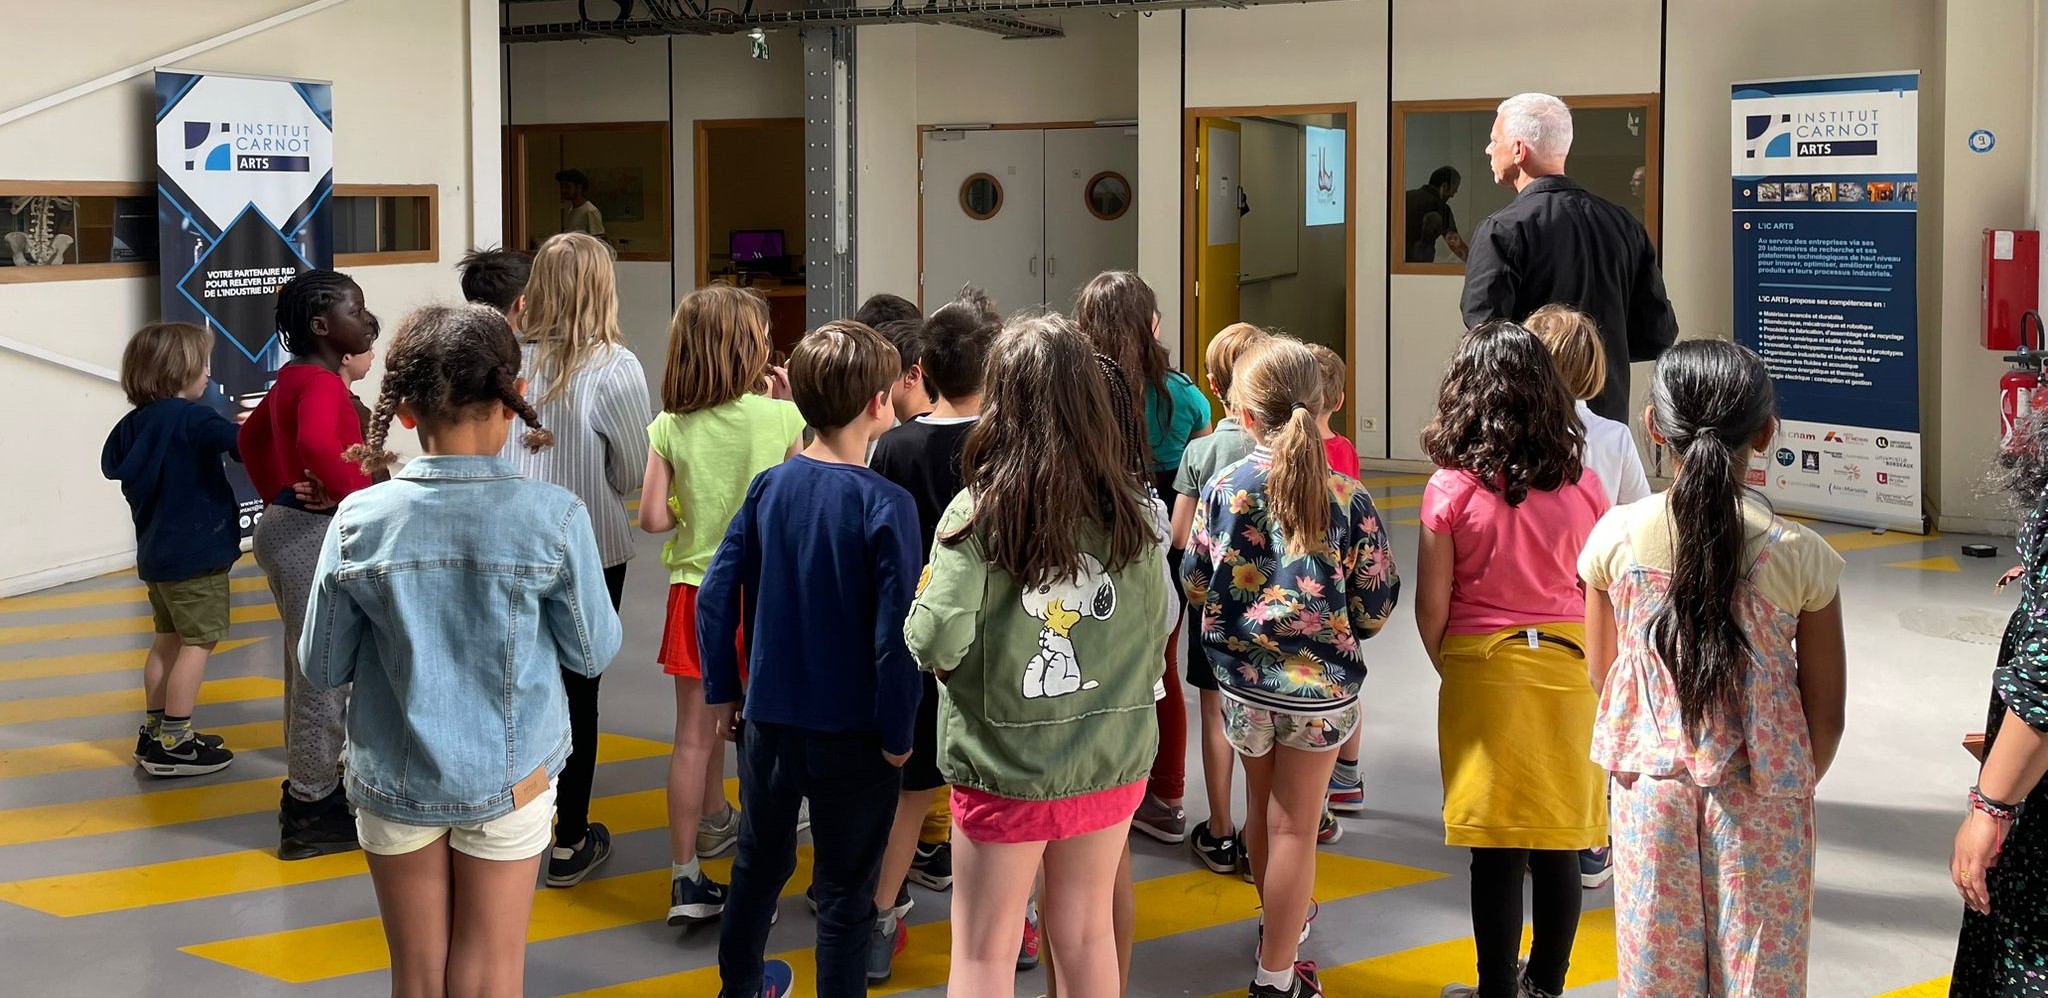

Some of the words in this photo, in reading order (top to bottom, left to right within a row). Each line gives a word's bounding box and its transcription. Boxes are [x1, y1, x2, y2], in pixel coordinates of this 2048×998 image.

[1798, 110, 1878, 123] INSTITUT
[236, 122, 310, 136] INSTITUT
[1796, 124, 1878, 138] CARNOT
[236, 137, 310, 152] CARNOT
[1800, 144, 1832, 155] ARTS
[240, 158, 270, 169] ARTS
[207, 270, 233, 279] VOTRE
[234, 268, 280, 277] PARTENAIRE
[281, 266, 296, 275] R&D
[206, 280, 228, 288] POUR
[230, 278, 262, 287] RELEVER
[262, 276, 276, 285] LES
[278, 274, 296, 284] DÉF
[204, 289, 216, 298] DE
[217, 286, 262, 298] L'INDUSTRIE
[263, 286, 275, 294] DU
[1788, 432, 1816, 440] cnam
